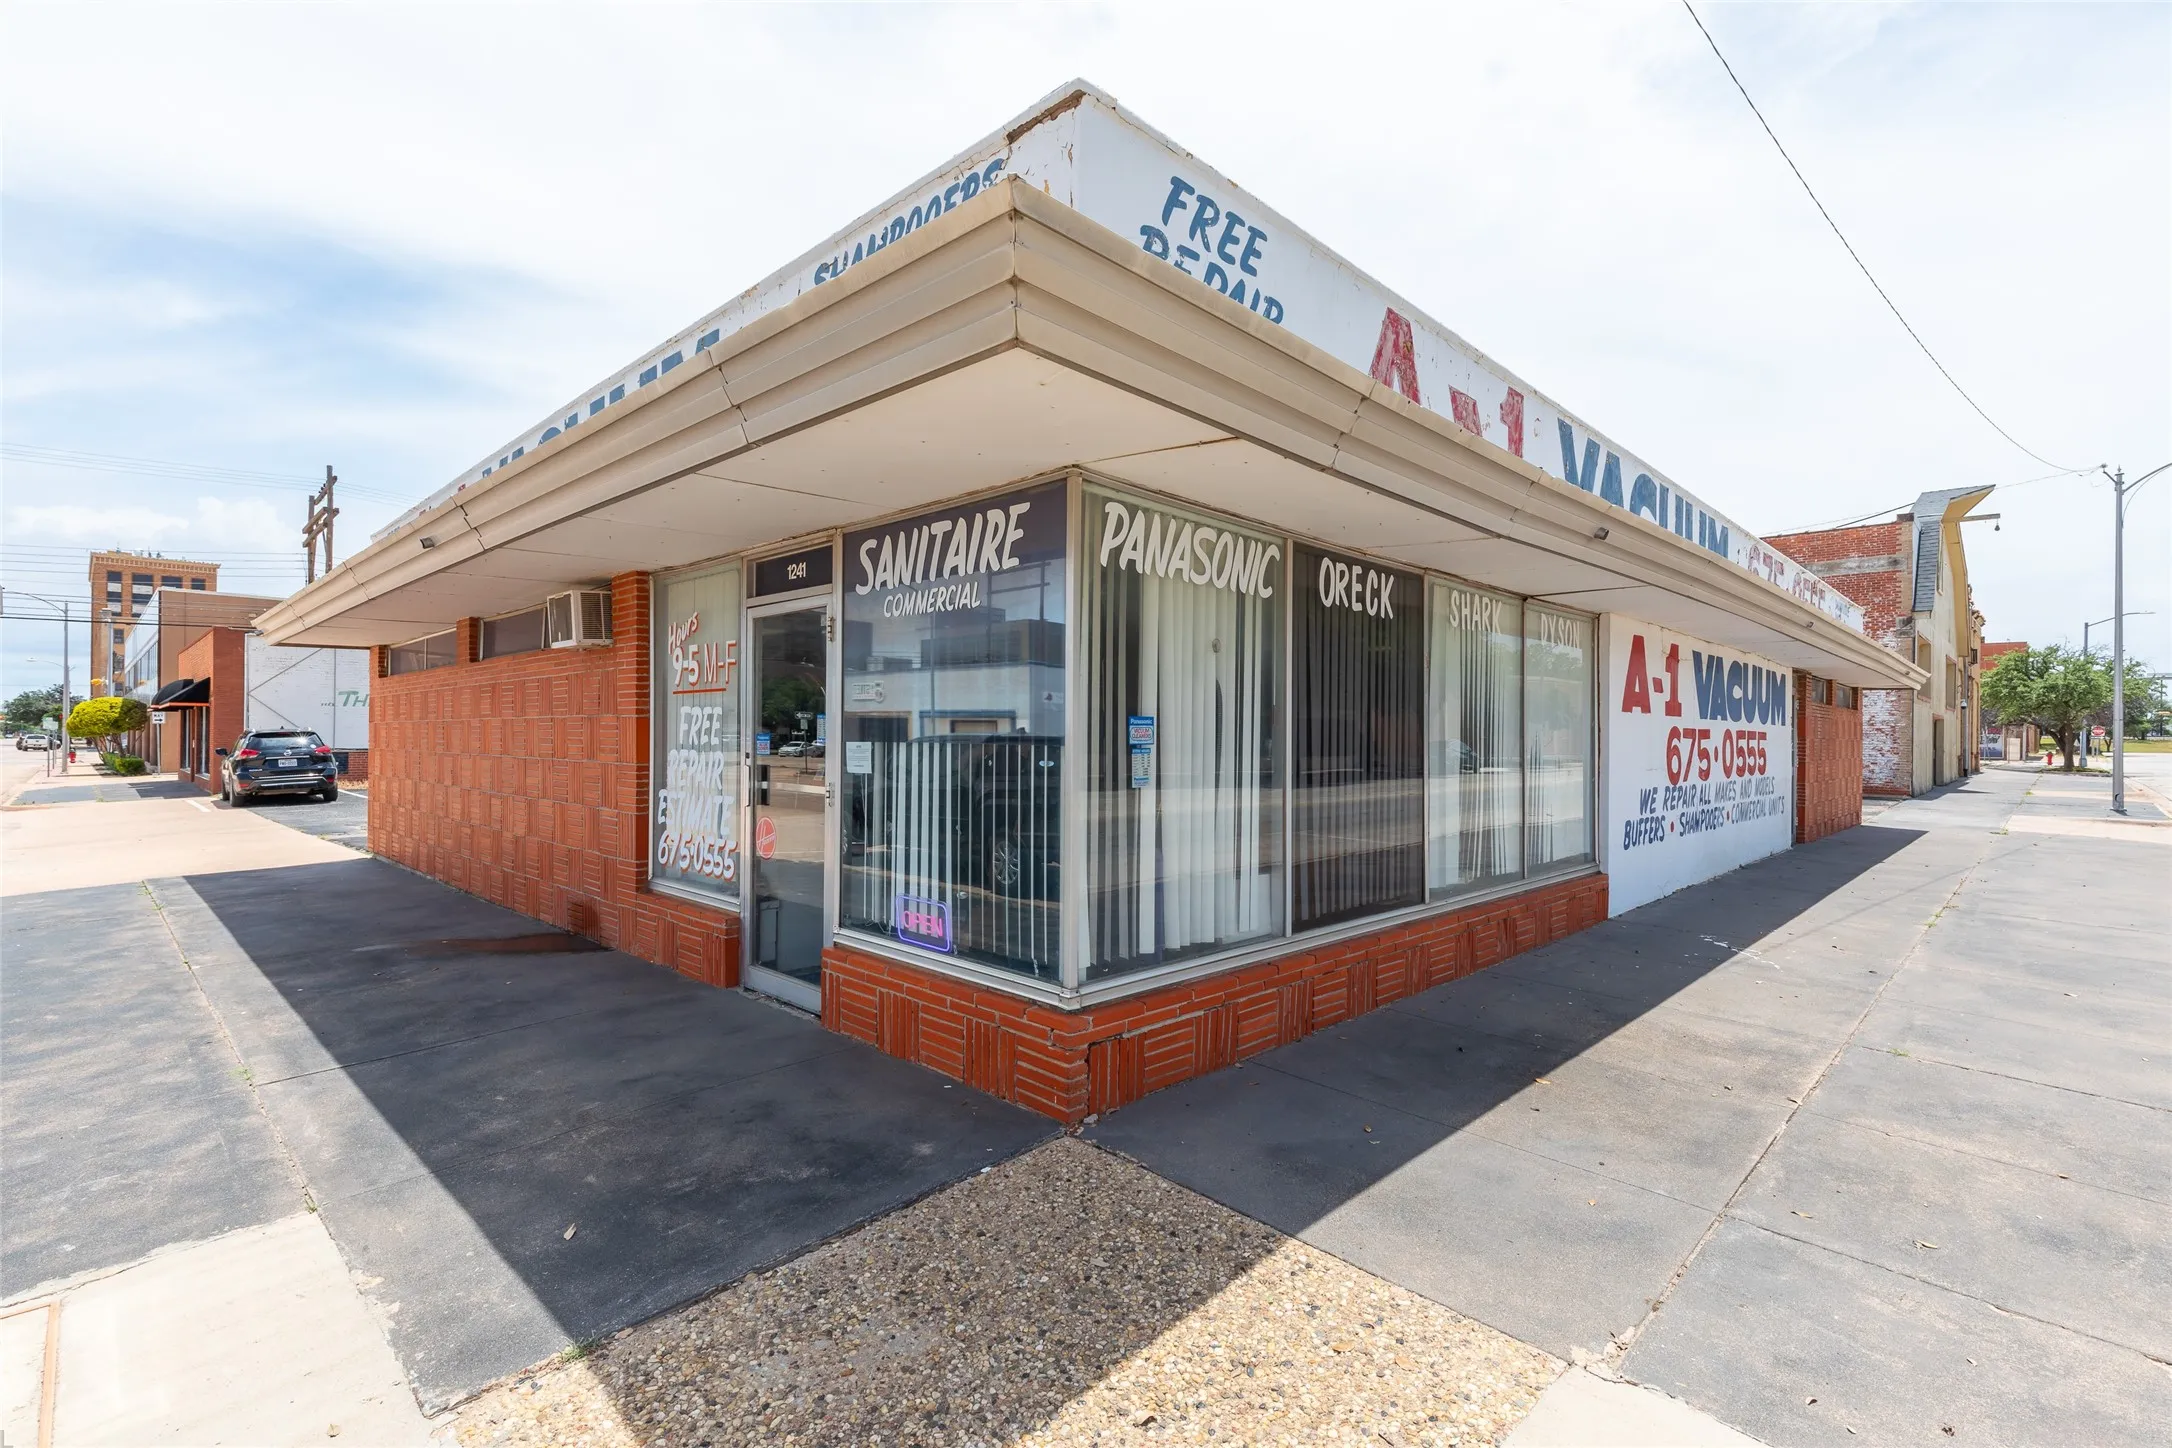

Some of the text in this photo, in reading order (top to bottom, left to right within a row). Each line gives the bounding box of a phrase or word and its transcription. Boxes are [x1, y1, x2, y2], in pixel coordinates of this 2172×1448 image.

[1161, 175, 1268, 277] FREE
[1368, 307, 1525, 458] A-1
[787, 562, 806, 580] 1241
[855, 502, 1031, 596] SANITAIRE
[1100, 502, 1280, 598] PANASONIC
[883, 582, 981, 618] COMMERCIAL
[1319, 557, 1395, 619] ORECK
[668, 611, 699, 655] Hours
[1449, 590, 1502, 635] SHARK
[1541, 612, 1580, 649] DYSON
[672, 640, 737, 687] 9-5 M-F
[1621, 634, 1786, 726] A-1 VACUUM
[679, 706, 723, 746] FREE
[668, 749, 724, 790] REPAIR
[657, 788, 735, 839] ESTIMATE
[1639, 776, 1776, 816] WE REPAIR ALL MAKES AND MODELS
[1623, 796, 1785, 851] BUFFERS SHAMPOOERS COMMERCIAL UNITS
[902, 910, 943, 937] OPEN
